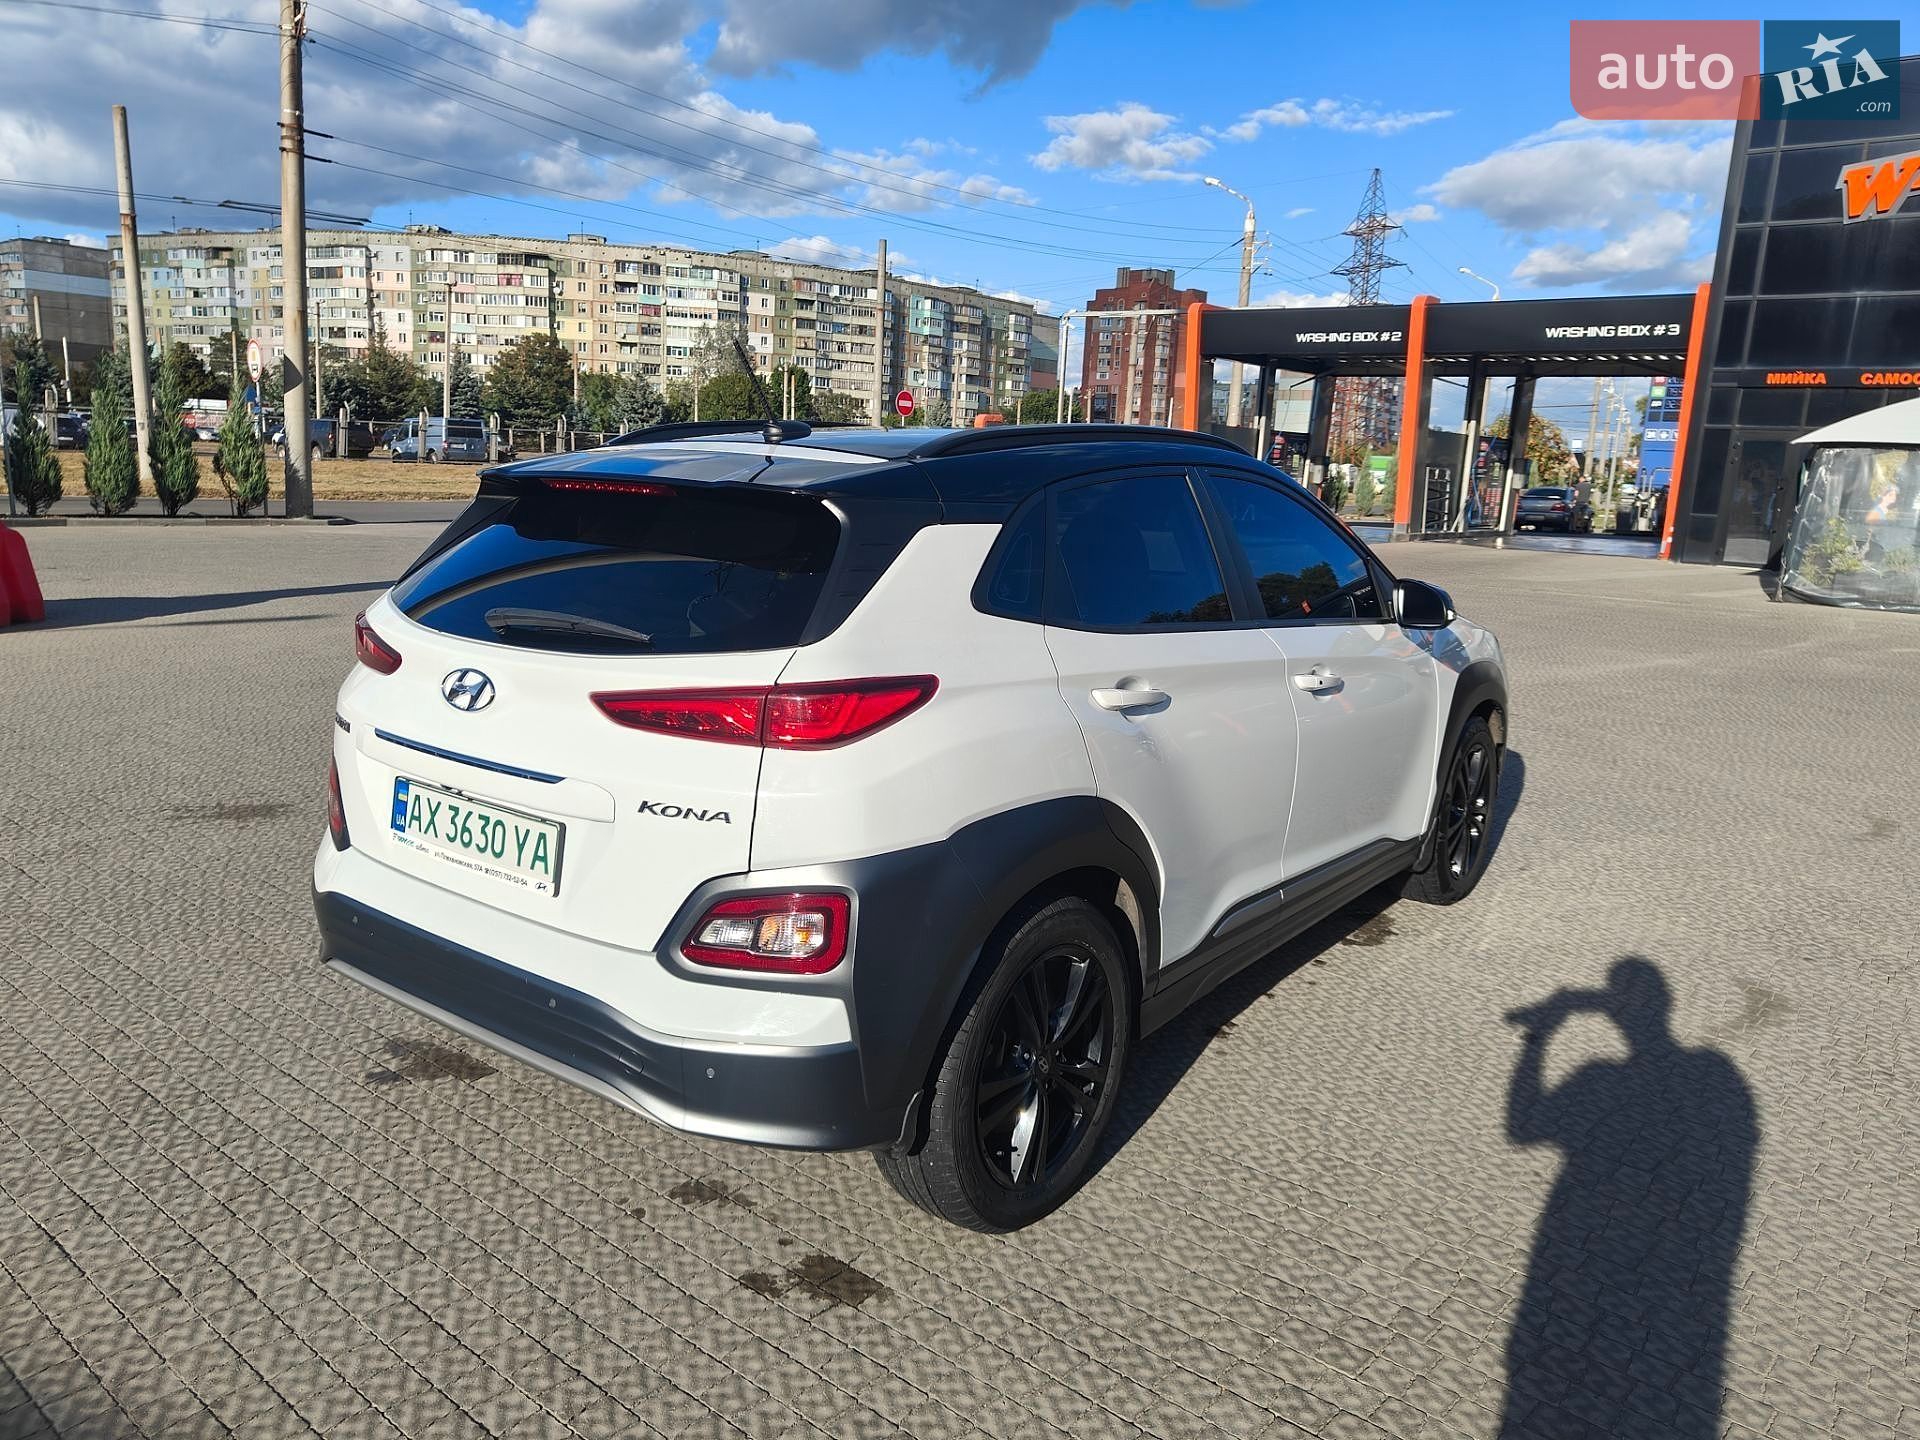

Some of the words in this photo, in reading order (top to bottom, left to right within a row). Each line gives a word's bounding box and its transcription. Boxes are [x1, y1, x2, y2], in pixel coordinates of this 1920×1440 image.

[1843, 154, 1920, 219] W
[1295, 332, 1352, 343] WASHING
[1352, 332, 1379, 342] BOX
[1545, 325, 1616, 338] WASHING
[1617, 324, 1652, 336] BOX
[1766, 370, 1827, 385] МИЙКА
[637, 800, 732, 824] KONA
[395, 813, 406, 828] UA
[408, 794, 442, 839] AX
[445, 804, 506, 859] 3630
[514, 824, 549, 875] YA
